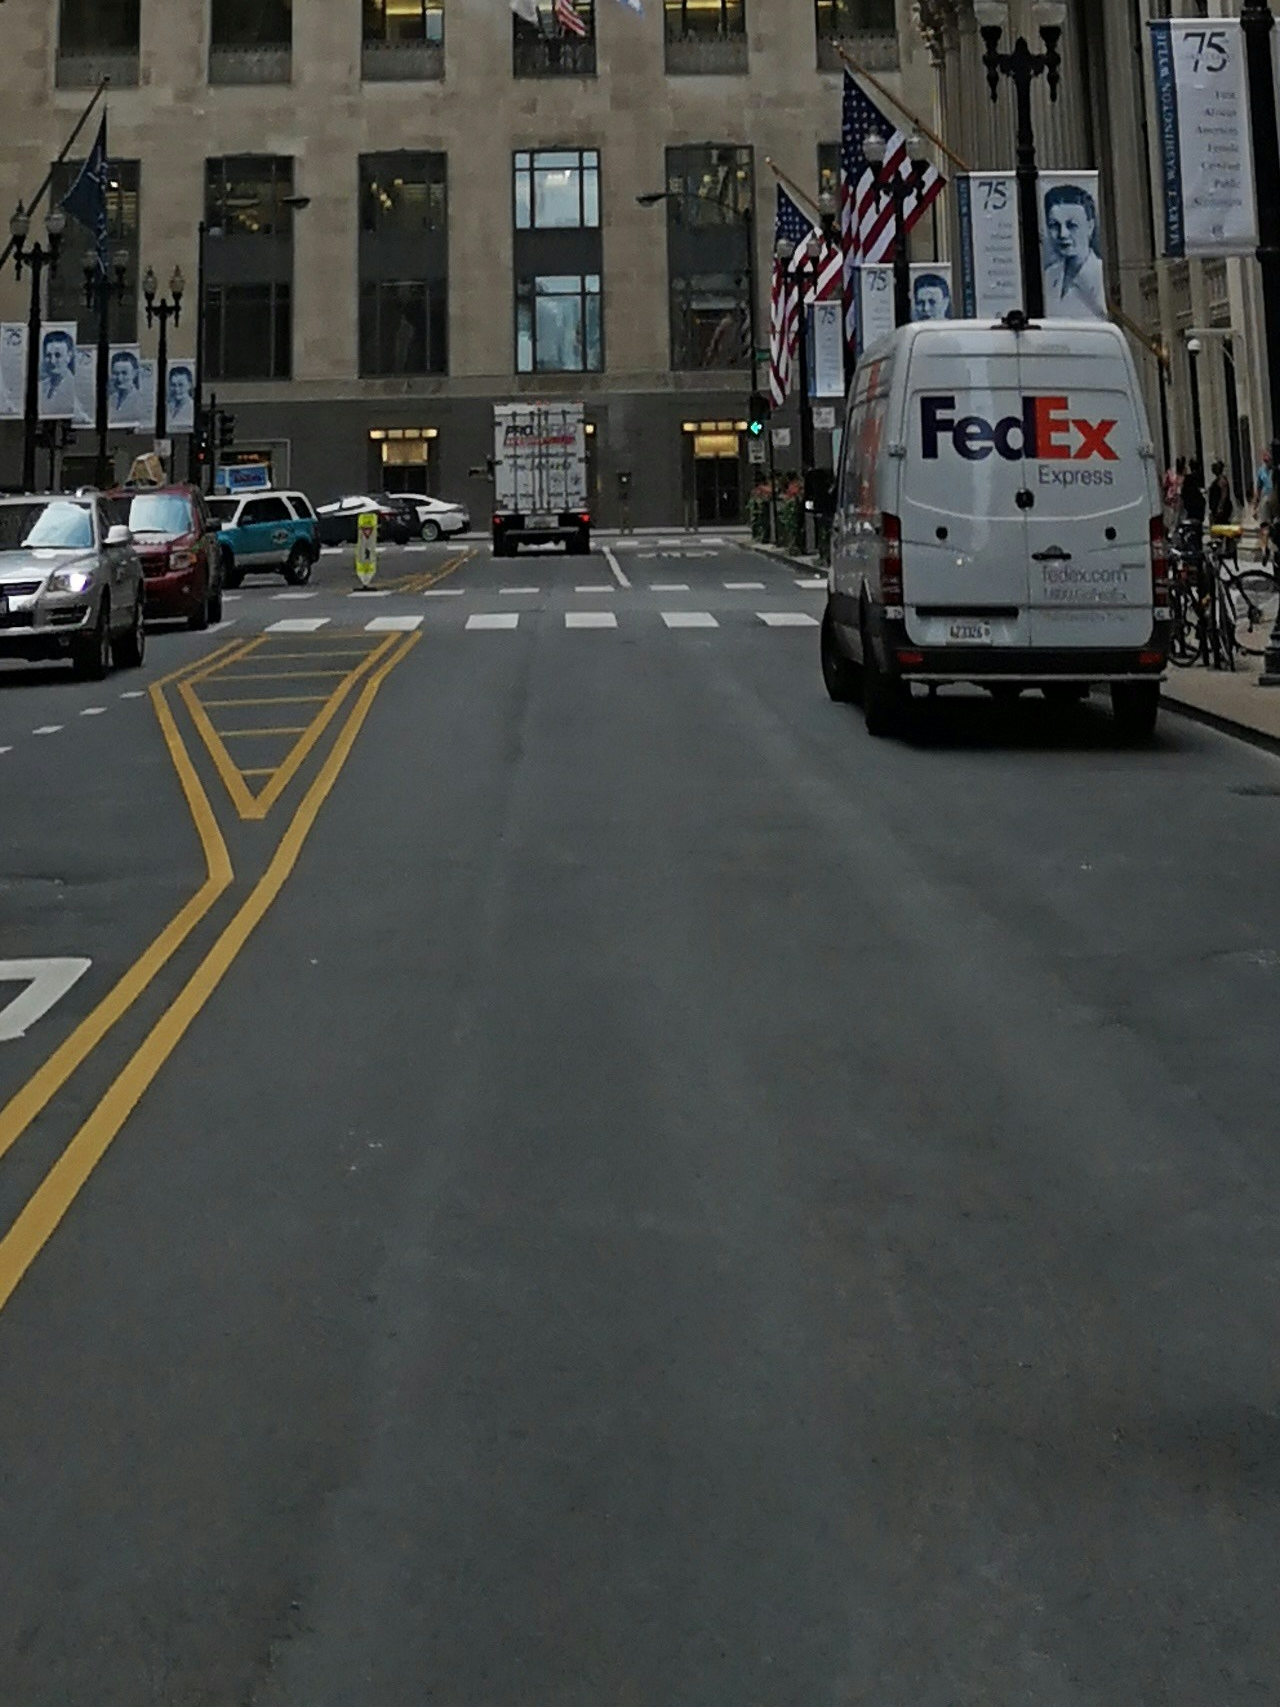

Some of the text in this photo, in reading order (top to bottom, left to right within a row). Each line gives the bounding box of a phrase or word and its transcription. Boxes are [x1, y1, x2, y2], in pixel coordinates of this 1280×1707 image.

[1183, 32, 1227, 73] 75
[920, 395, 1120, 461] FedEx
[1038, 464, 1114, 487] Express
